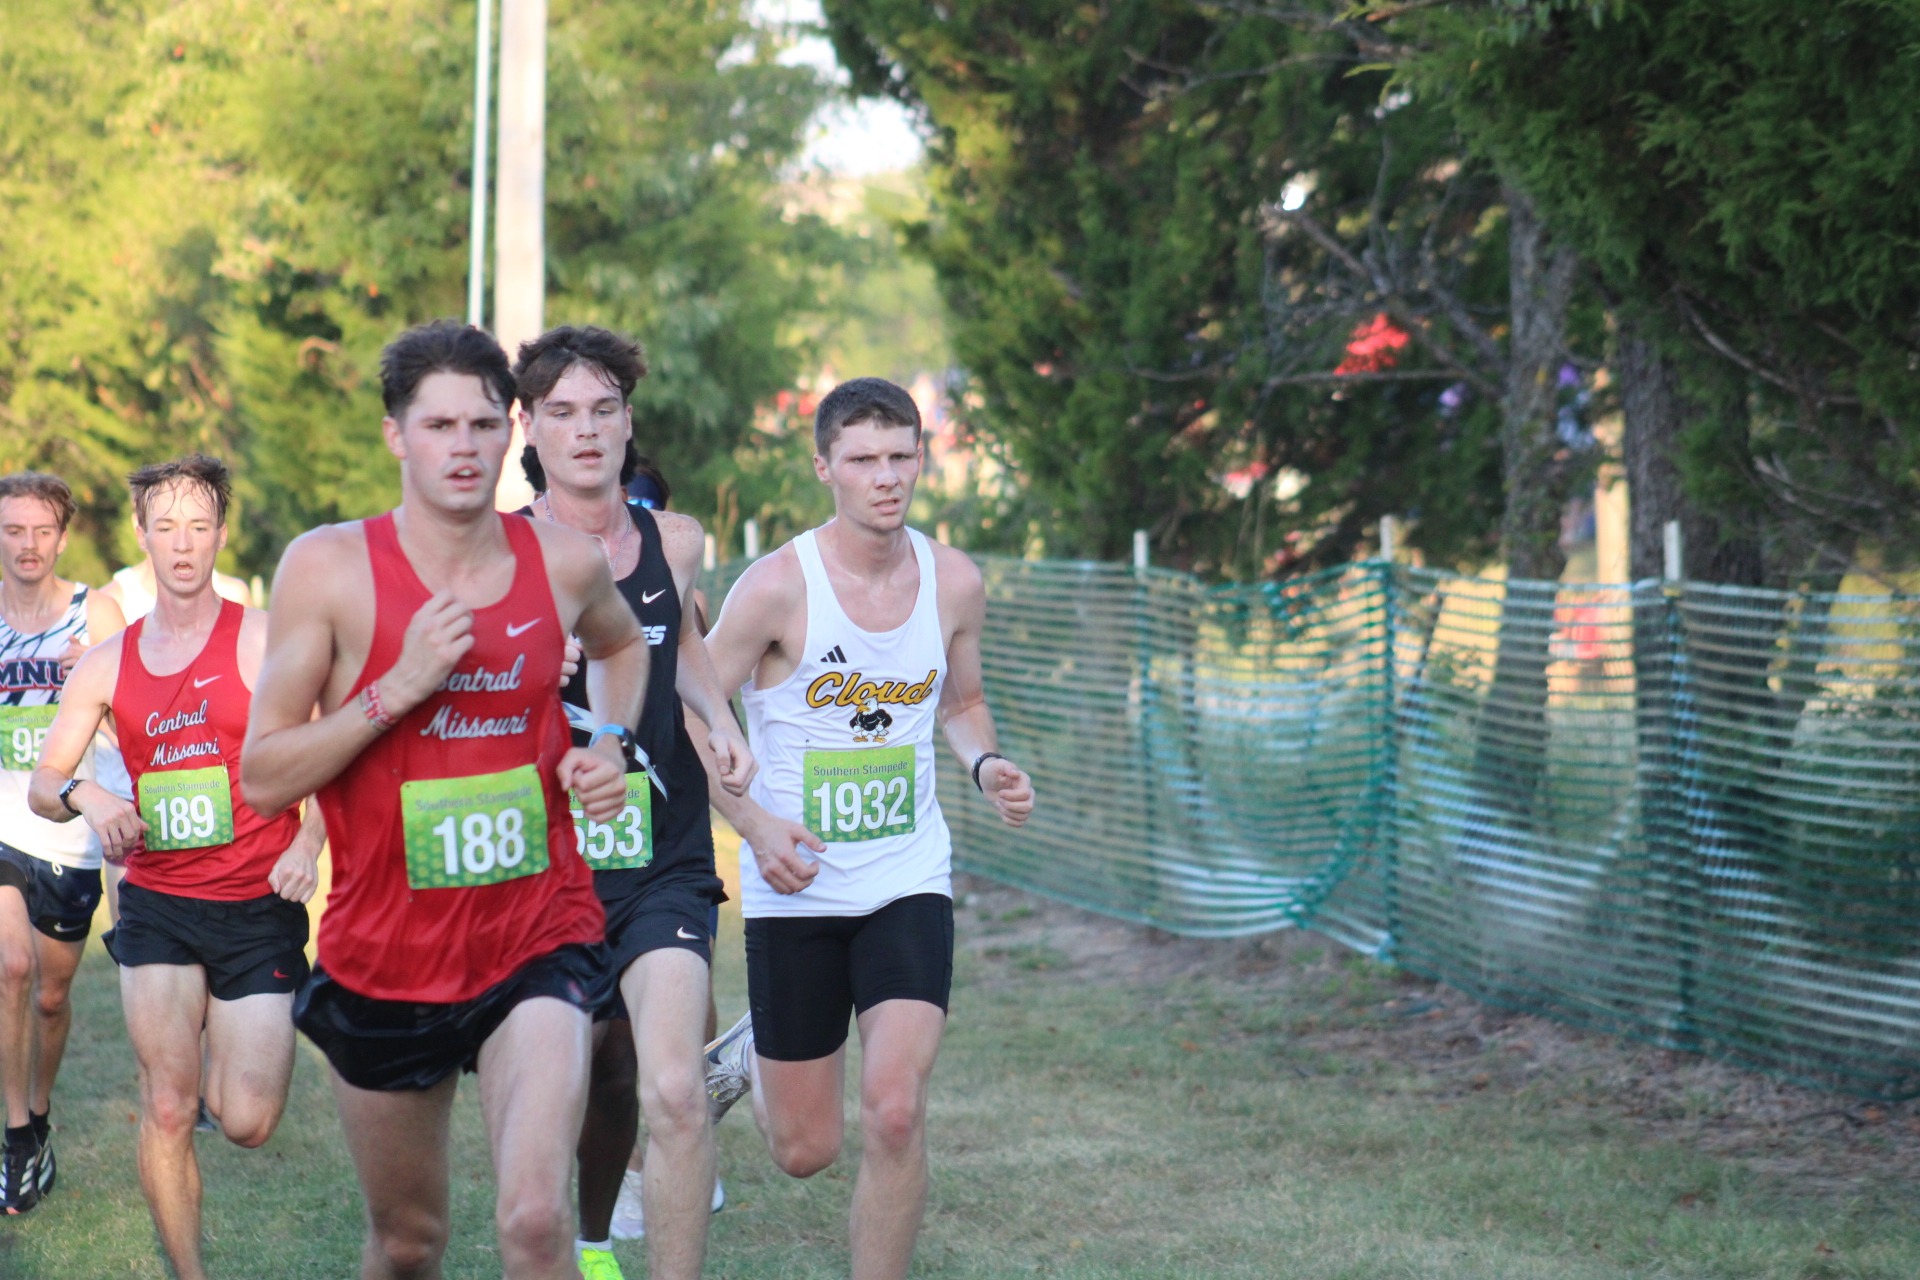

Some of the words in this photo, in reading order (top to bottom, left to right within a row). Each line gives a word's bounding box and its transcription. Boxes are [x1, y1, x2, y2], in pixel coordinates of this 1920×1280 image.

[436, 653, 526, 692] entral
[806, 669, 937, 708] Cloud
[145, 699, 208, 737] Central
[420, 705, 531, 740] Missouri
[150, 737, 220, 767] Missouri
[813, 765, 860, 777] Southern
[863, 760, 908, 776] Stampede
[144, 783, 176, 795] Southern
[177, 780, 221, 792] Stampede
[415, 797, 473, 812] Southern
[476, 785, 532, 806] Stampede
[812, 776, 908, 832] 1932
[154, 794, 215, 841] 189
[432, 807, 526, 875] 188
